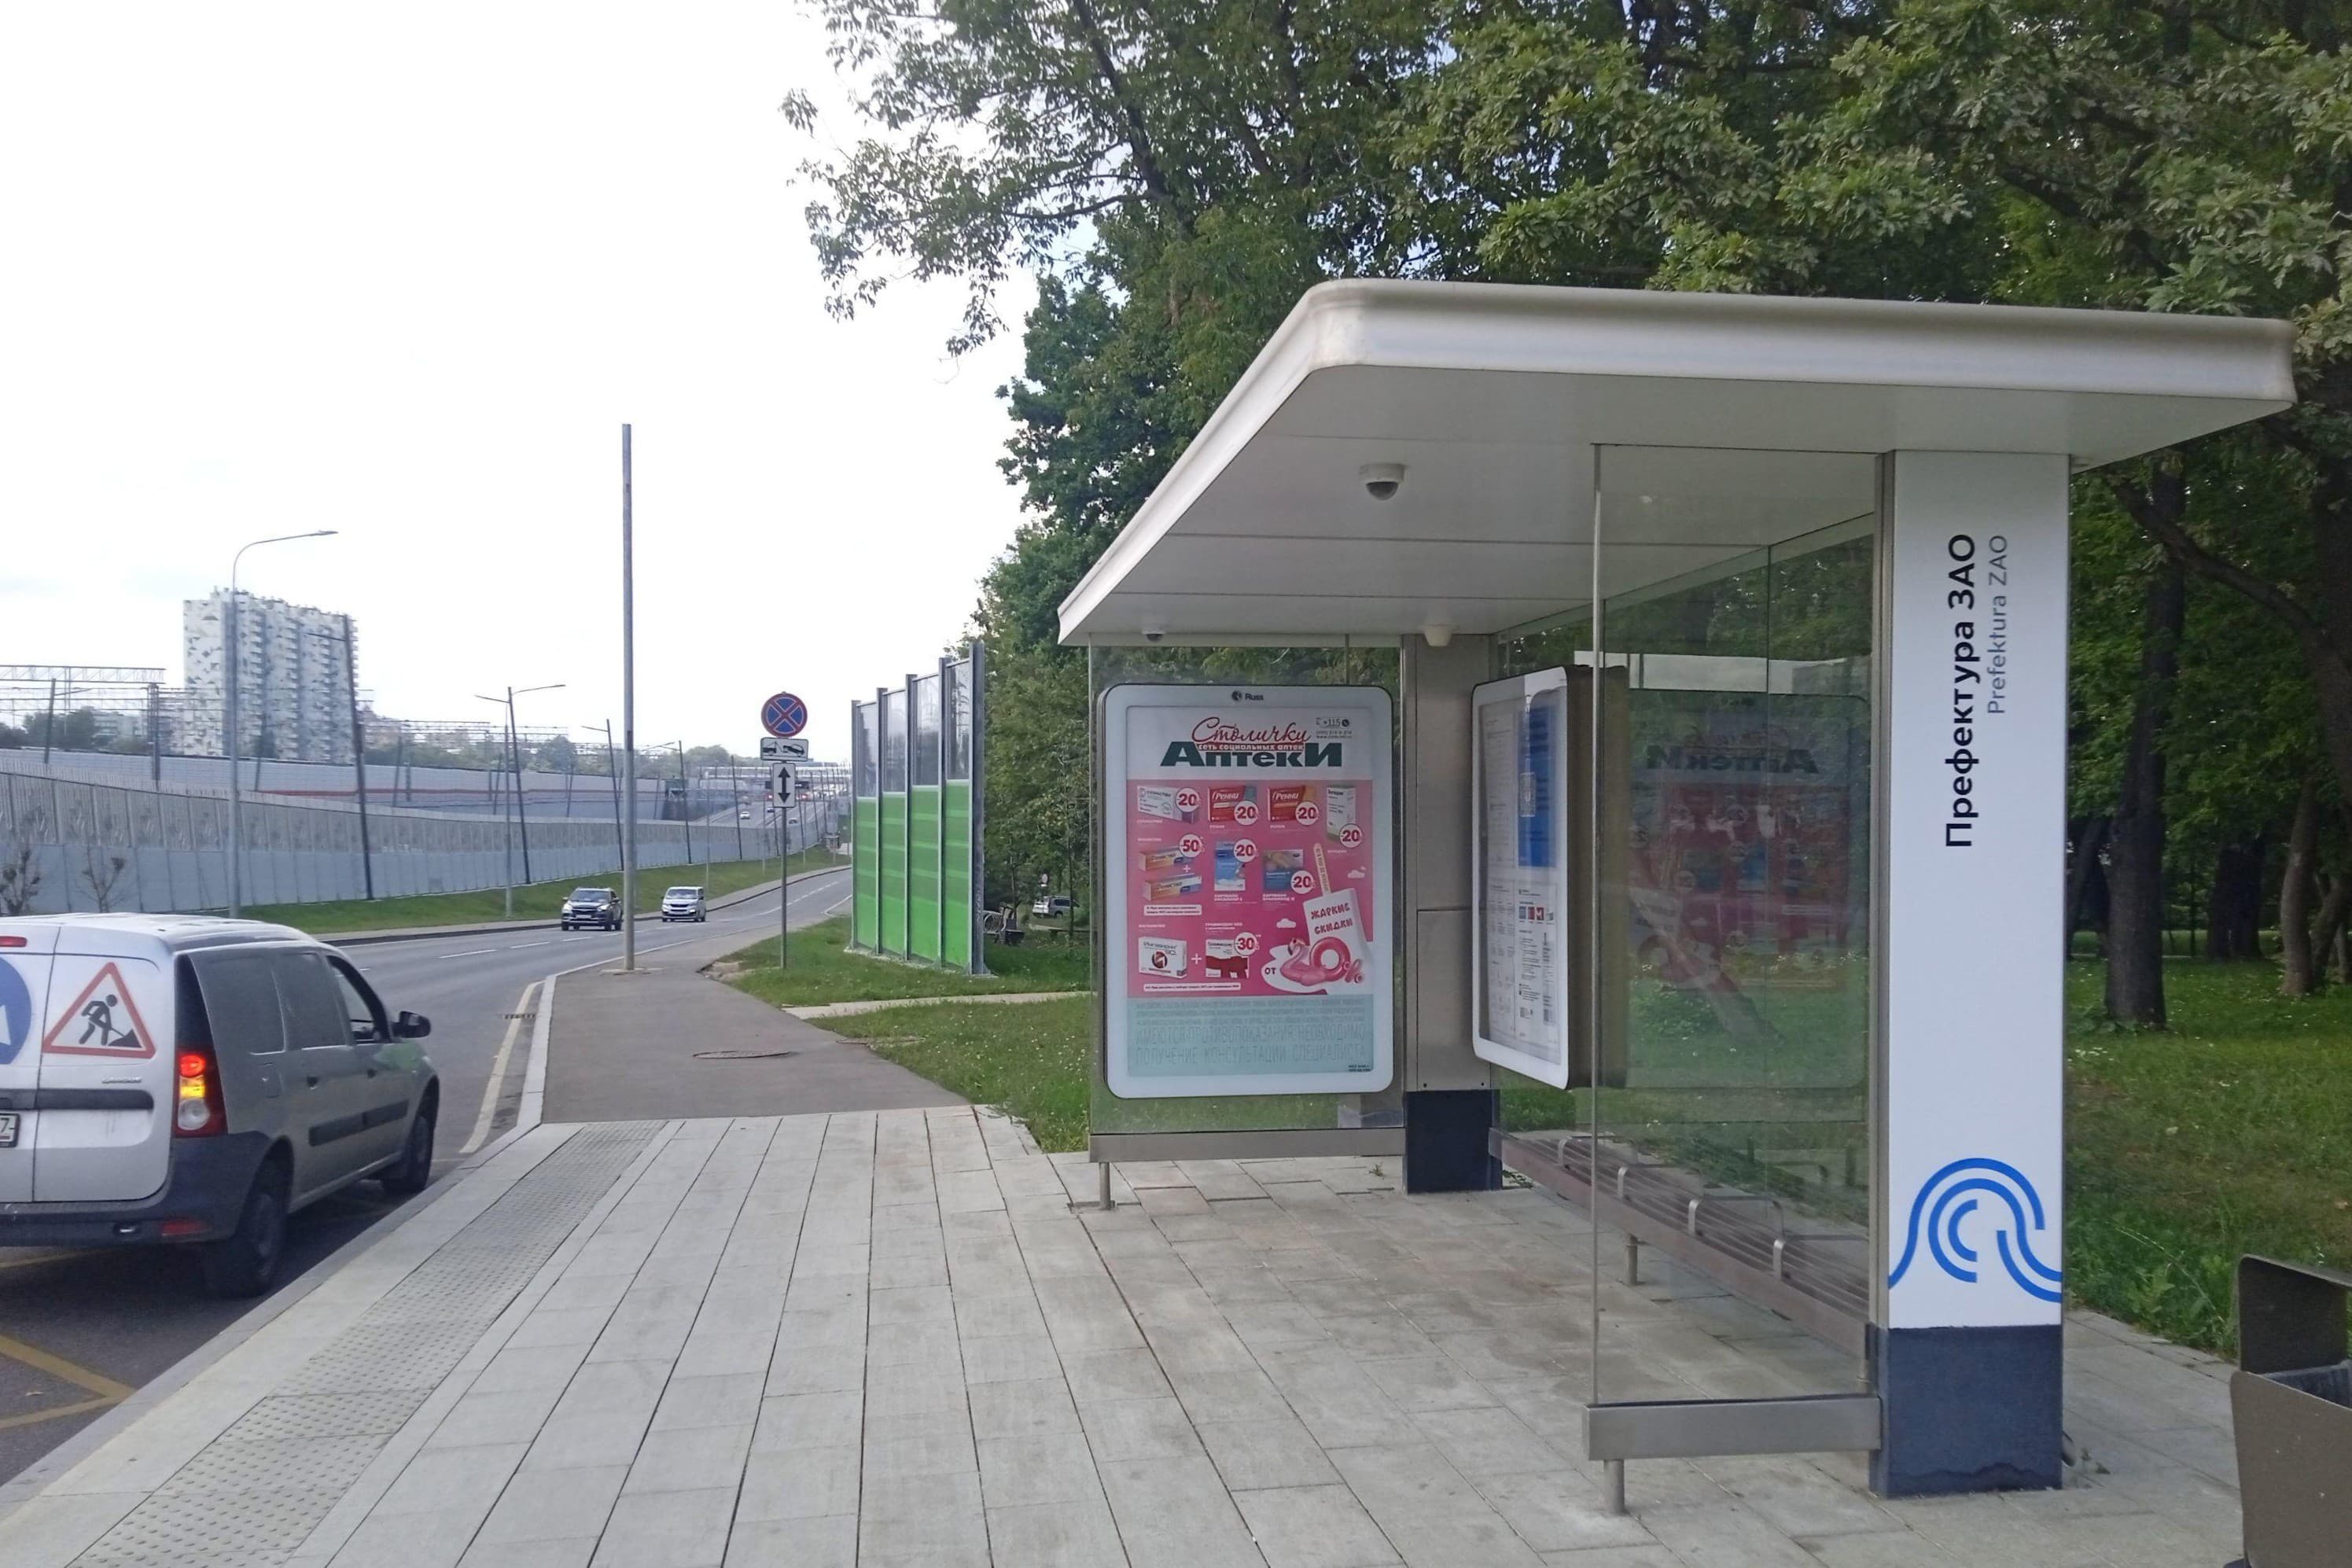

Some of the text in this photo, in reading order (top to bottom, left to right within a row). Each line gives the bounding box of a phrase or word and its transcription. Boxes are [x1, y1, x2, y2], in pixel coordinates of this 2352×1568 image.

[1987, 535, 2008, 714] Prefektura ZAO
[1945, 534, 1980, 847] Префектура ЗАО
[1191, 716, 1312, 742] Столички
[1310, 902, 1351, 920] ЖАРКИЕ
[1314, 918, 1353, 935] СКИДКИ
